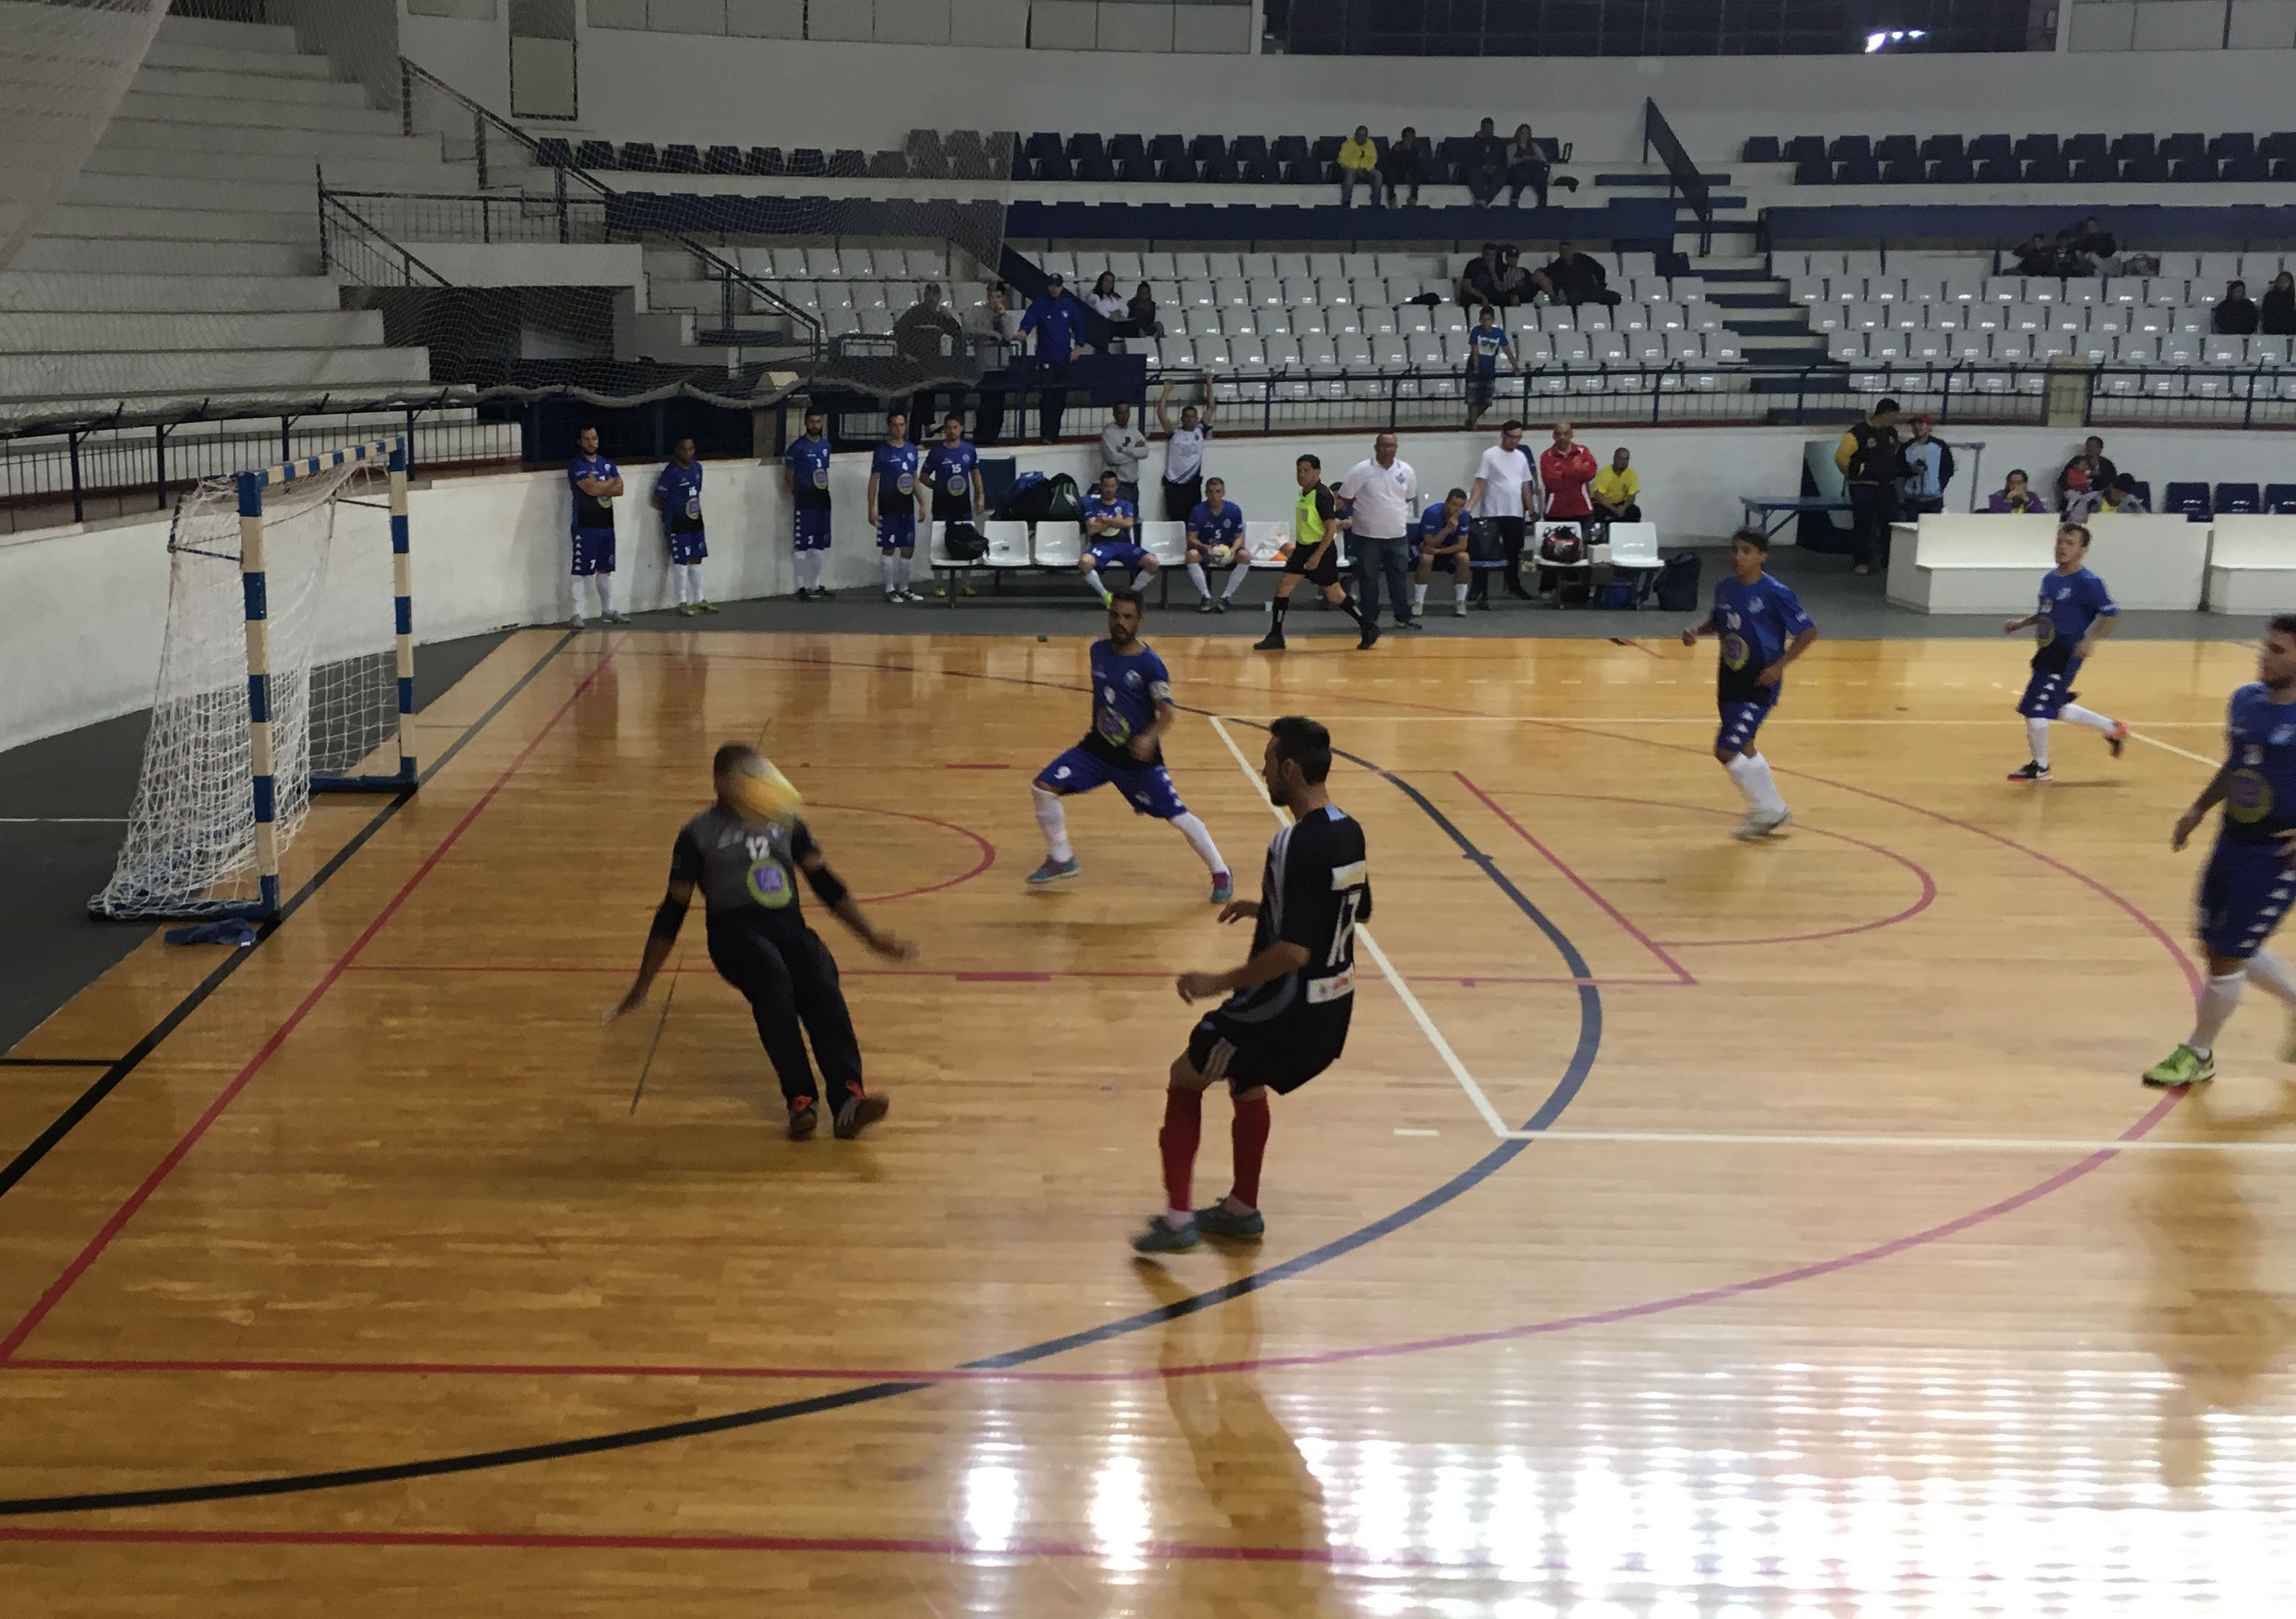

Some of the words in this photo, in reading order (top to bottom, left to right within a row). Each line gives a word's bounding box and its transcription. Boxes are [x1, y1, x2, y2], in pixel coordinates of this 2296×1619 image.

[816, 458, 823, 468] 3
[902, 461, 908, 471] 4
[951, 463, 962, 474] 15
[807, 535, 814, 545] 3
[888, 534, 895, 544] 4
[1326, 890, 1362, 967] 17
